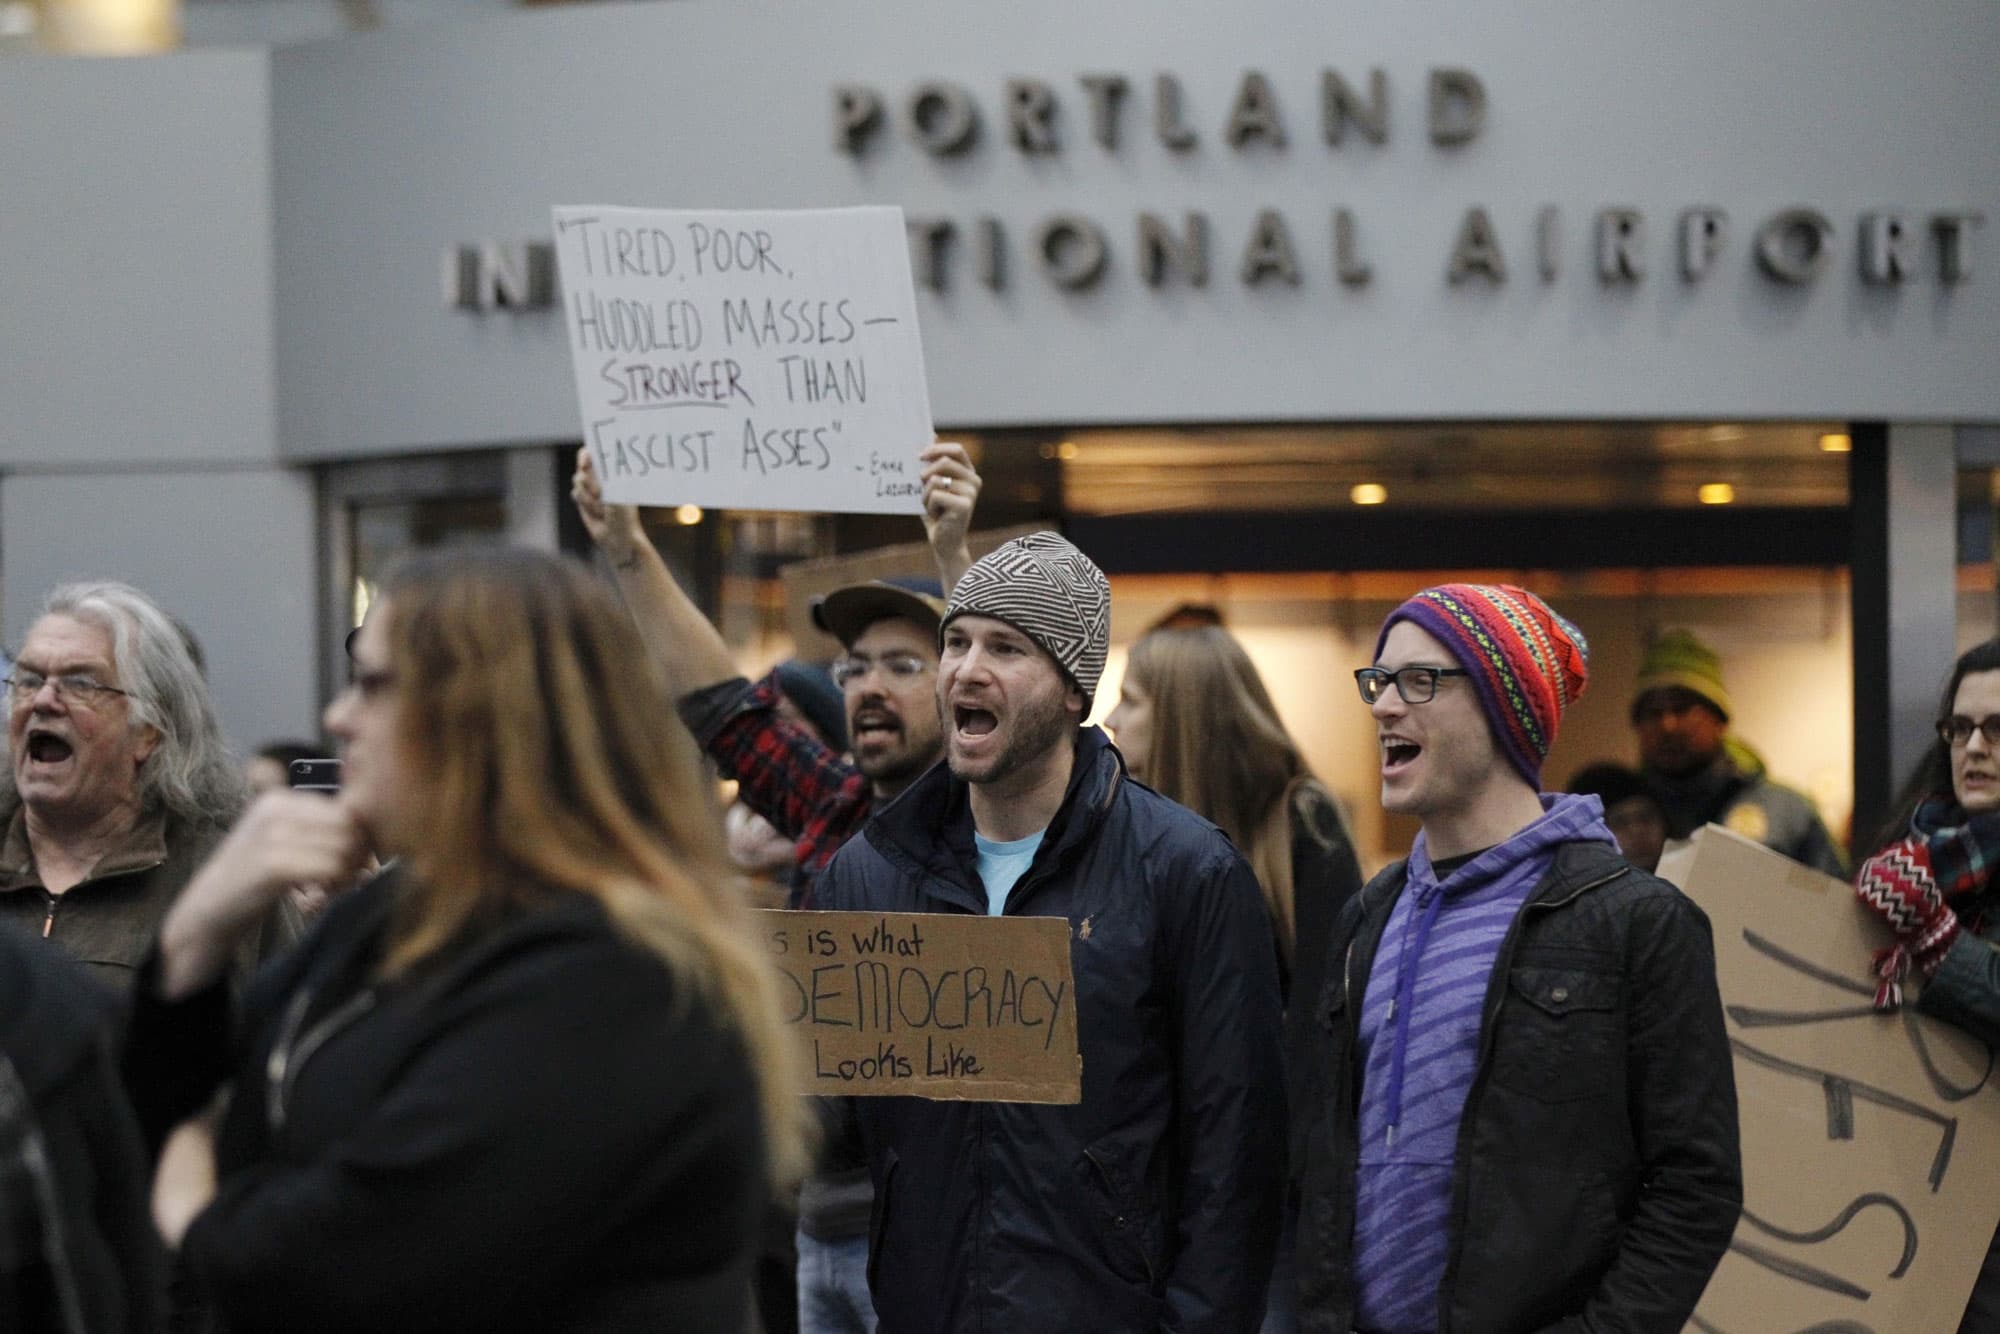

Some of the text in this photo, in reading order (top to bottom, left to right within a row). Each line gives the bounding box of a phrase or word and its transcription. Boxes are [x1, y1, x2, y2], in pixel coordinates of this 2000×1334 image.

[831, 67, 1488, 157] PORTLAND
[1447, 204, 1985, 288] AIRPORT
[574, 292, 703, 352] HUDDLED
[601, 355, 867, 407] STRONGER THAN
[592, 417, 842, 482] FASCIST ASSES"
[807, 929, 838, 956] is
[851, 918, 924, 957] what
[814, 1035, 986, 1081] Looks Like
